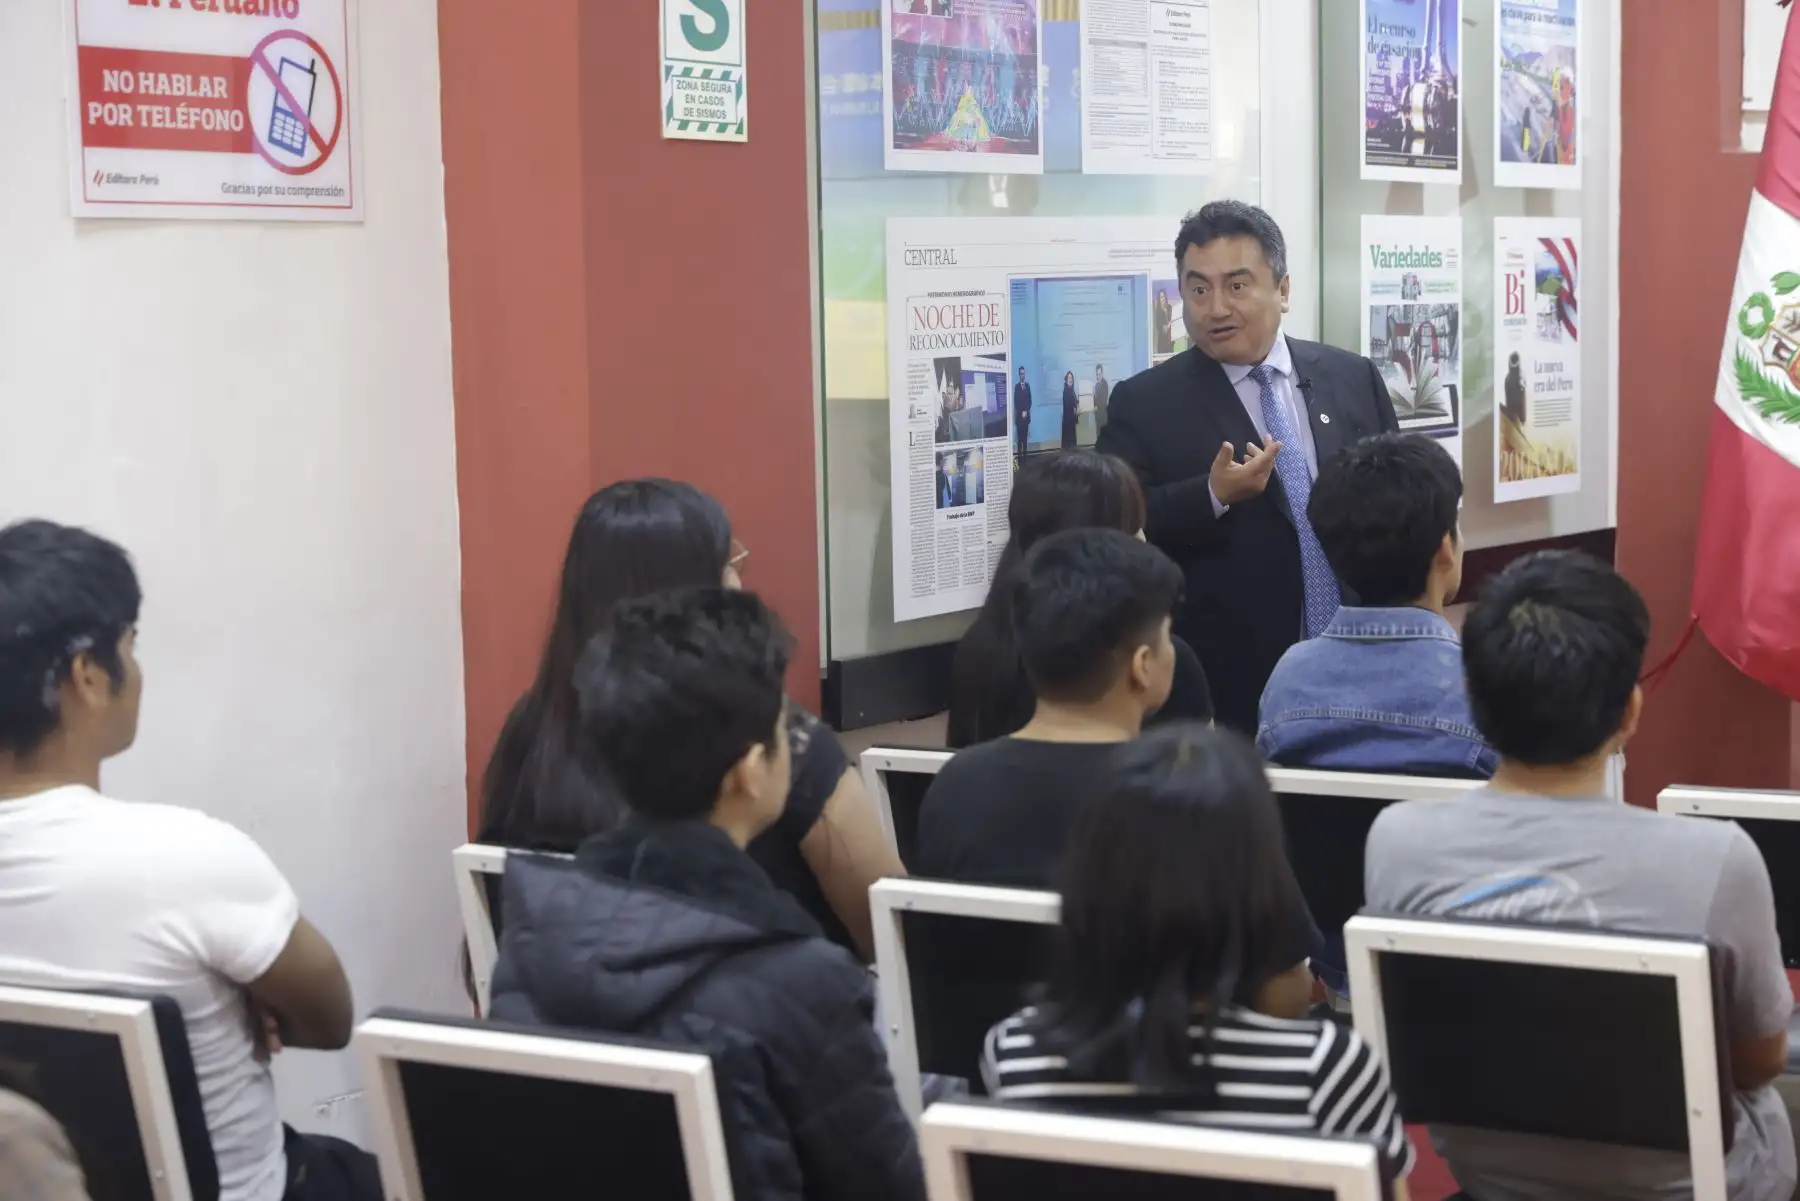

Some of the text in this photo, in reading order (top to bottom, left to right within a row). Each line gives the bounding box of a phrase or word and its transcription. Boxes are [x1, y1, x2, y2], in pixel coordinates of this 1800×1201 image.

[679, 0, 729, 51] S
[1368, 15, 1416, 39] El recurso
[1367, 38, 1379, 55] de
[103, 69, 228, 98] NO HABLAR
[676, 80, 732, 94] ZONA SEGURA
[685, 94, 725, 106] EN CASOS
[88, 101, 244, 132] POR TELÉFONO
[683, 107, 728, 120] DE SISMOS
[106, 172, 138, 185] Editora
[221, 182, 345, 199] Gracias por su comprensión
[904, 248, 958, 266] CENTRAL
[1369, 244, 1443, 269] Variedades
[1504, 269, 1526, 315] Bi
[913, 303, 1000, 331] NOCHE DE
[909, 330, 1005, 351] RECONOCIMIENTO
[1534, 359, 1564, 375] La nueva
[1534, 379, 1546, 393] era
[1546, 376, 1557, 393] del
